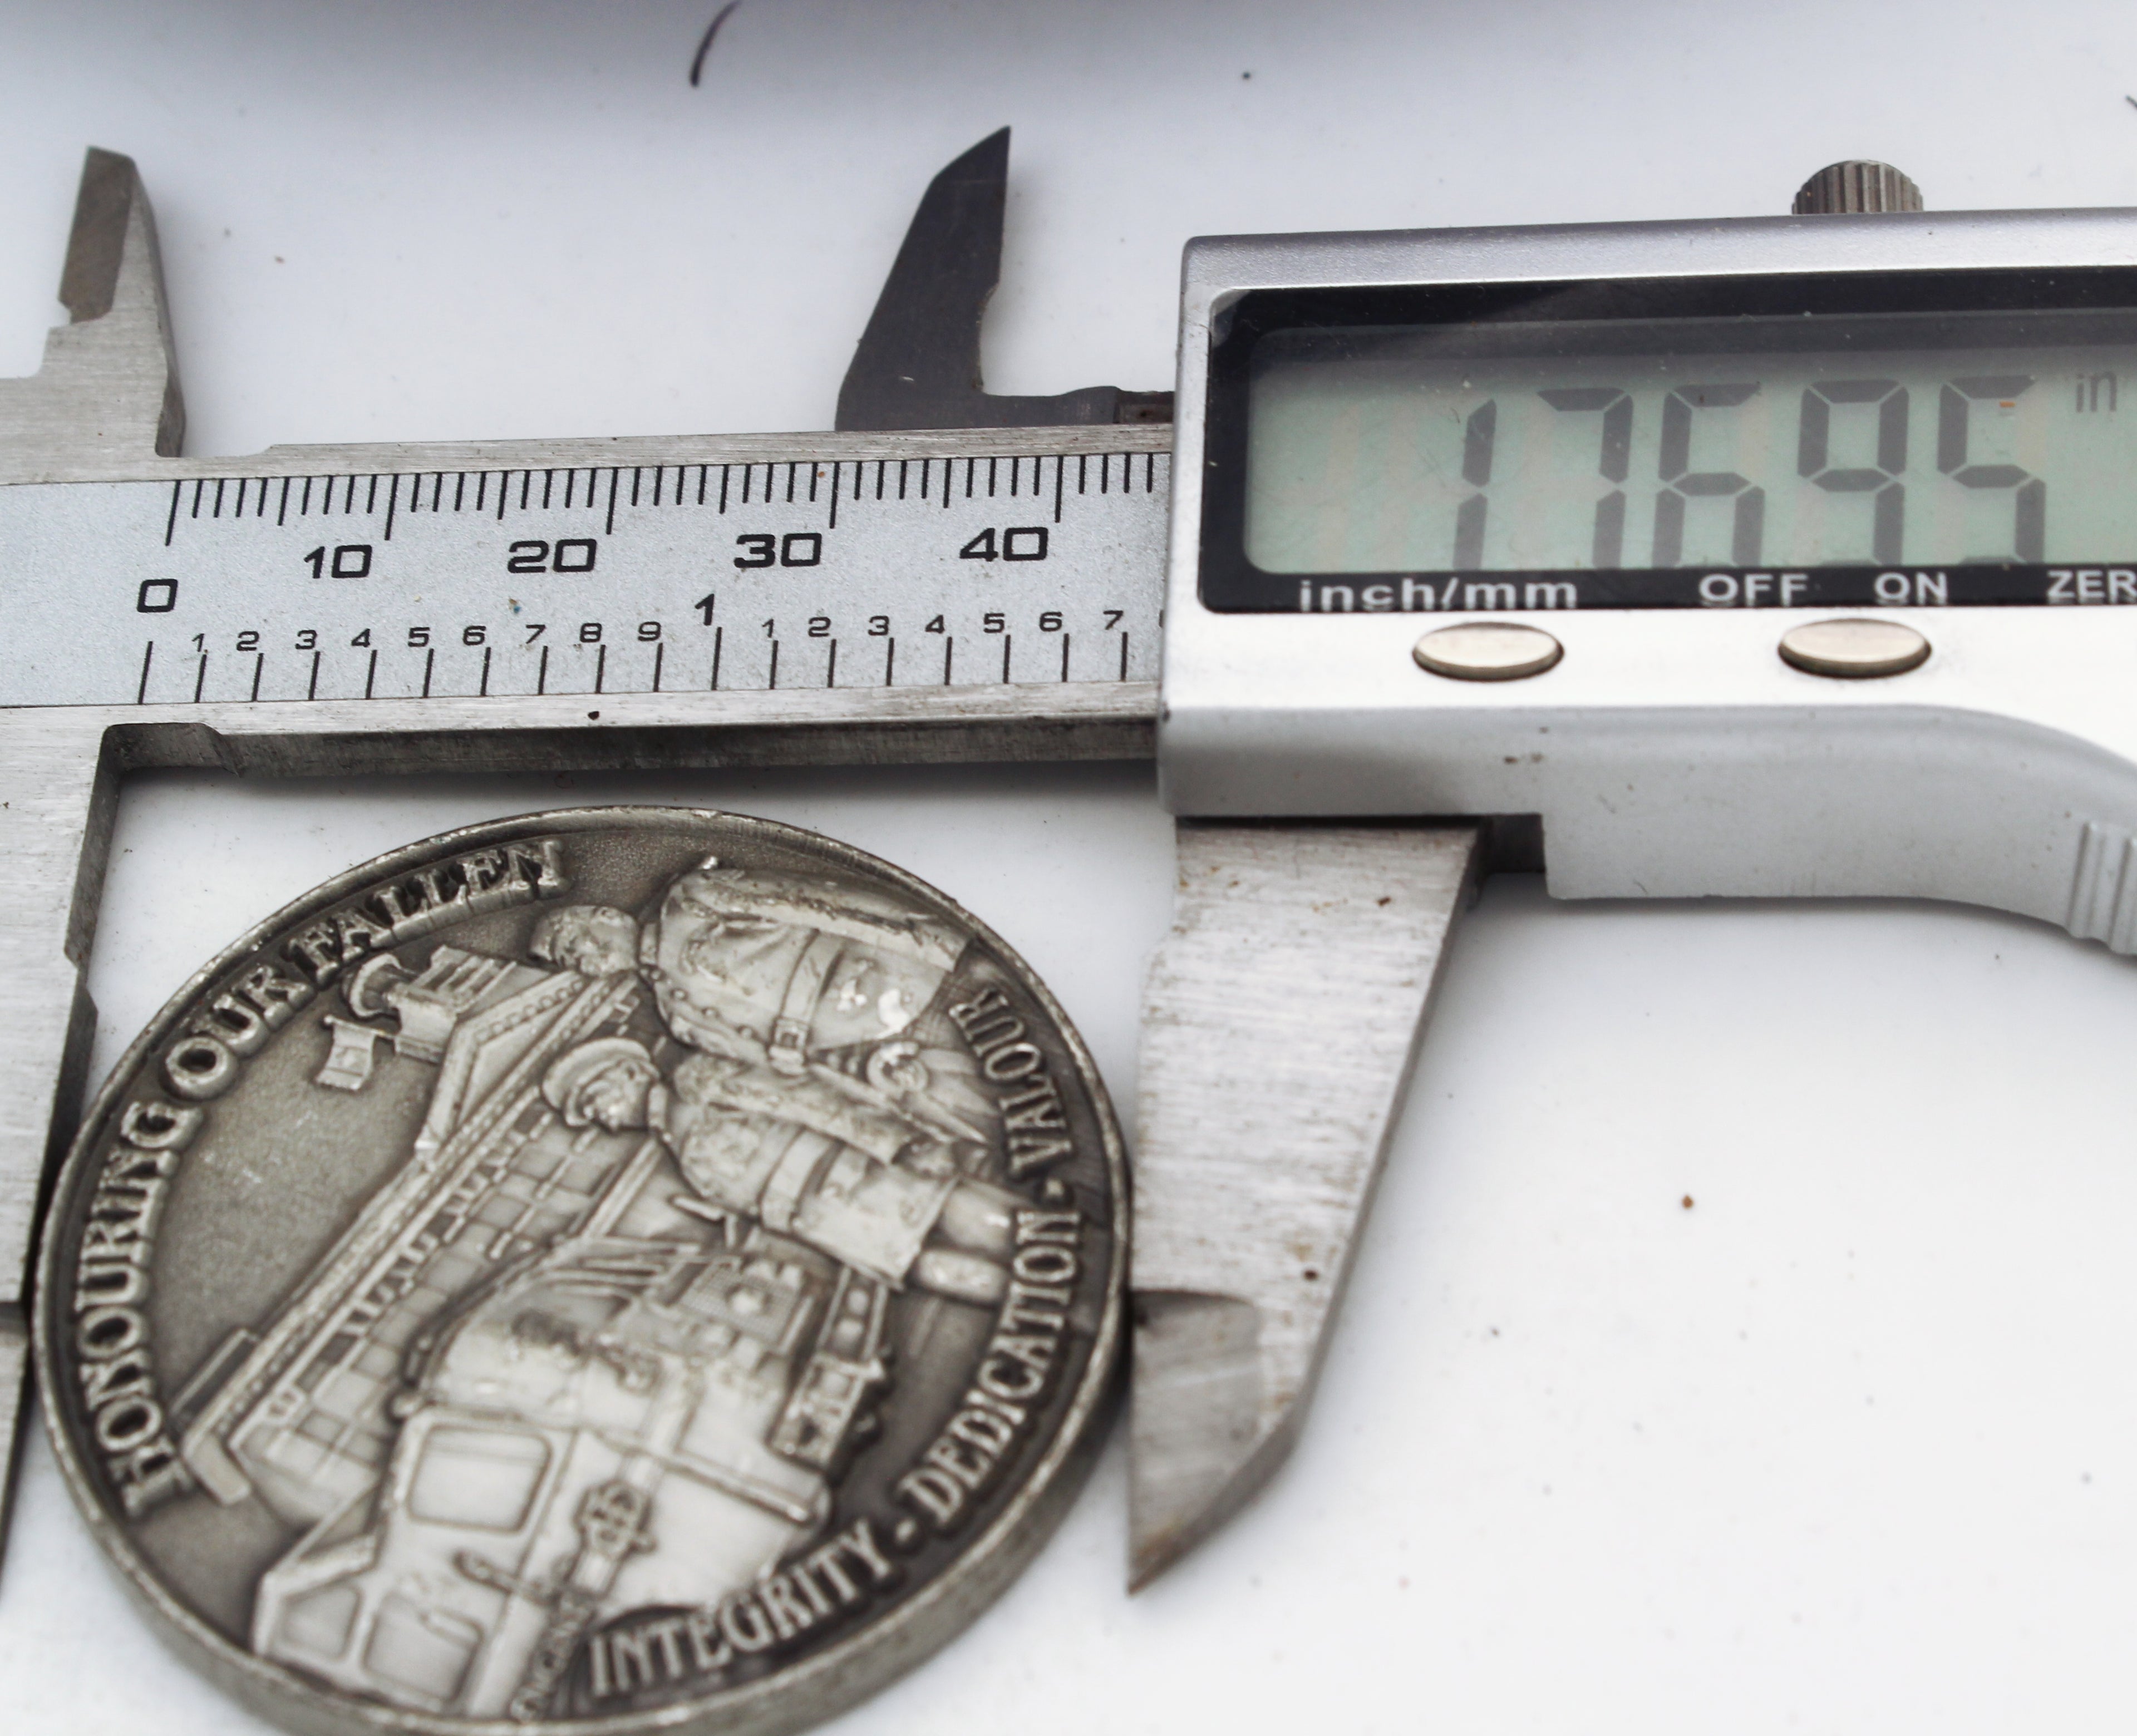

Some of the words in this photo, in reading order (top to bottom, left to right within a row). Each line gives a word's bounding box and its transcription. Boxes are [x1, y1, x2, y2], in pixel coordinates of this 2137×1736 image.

[2076, 372, 2117, 412] in
[303, 544, 373, 579] 10
[507, 538, 597, 574] 20
[733, 532, 823, 570] 30
[959, 526, 1048, 562] 40
[136, 578, 178, 613] 0
[1299, 577, 1578, 611] inch/mm
[1699, 574, 1809, 603] OFF
[1874, 572, 1948, 603] ON
[192, 633, 206, 652] 1
[236, 631, 259, 652] 2
[295, 629, 318, 650] 3
[351, 628, 372, 648] 4
[407, 627, 430, 648] 5
[462, 625, 486, 646] 6
[525, 624, 546, 644] 7
[579, 623, 602, 643] 8
[638, 621, 661, 642] 9
[695, 593, 715, 626] 1
[762, 619, 774, 638] 1
[808, 617, 831, 638] 2
[868, 615, 889, 636] 3
[925, 614, 946, 634] 4
[983, 613, 1005, 634] 5
[1039, 611, 1062, 632] 6
[1102, 610, 1124, 630] 7
[948, 988, 1073, 1175] VALOUR
[75, 1101, 204, 1516] HONOURING
[165, 965, 313, 1097] OUR
[287, 839, 569, 990] FALLEN
[898, 1210, 1081, 1525] DEDICATION
[589, 1520, 890, 1698] INTEGRITY
